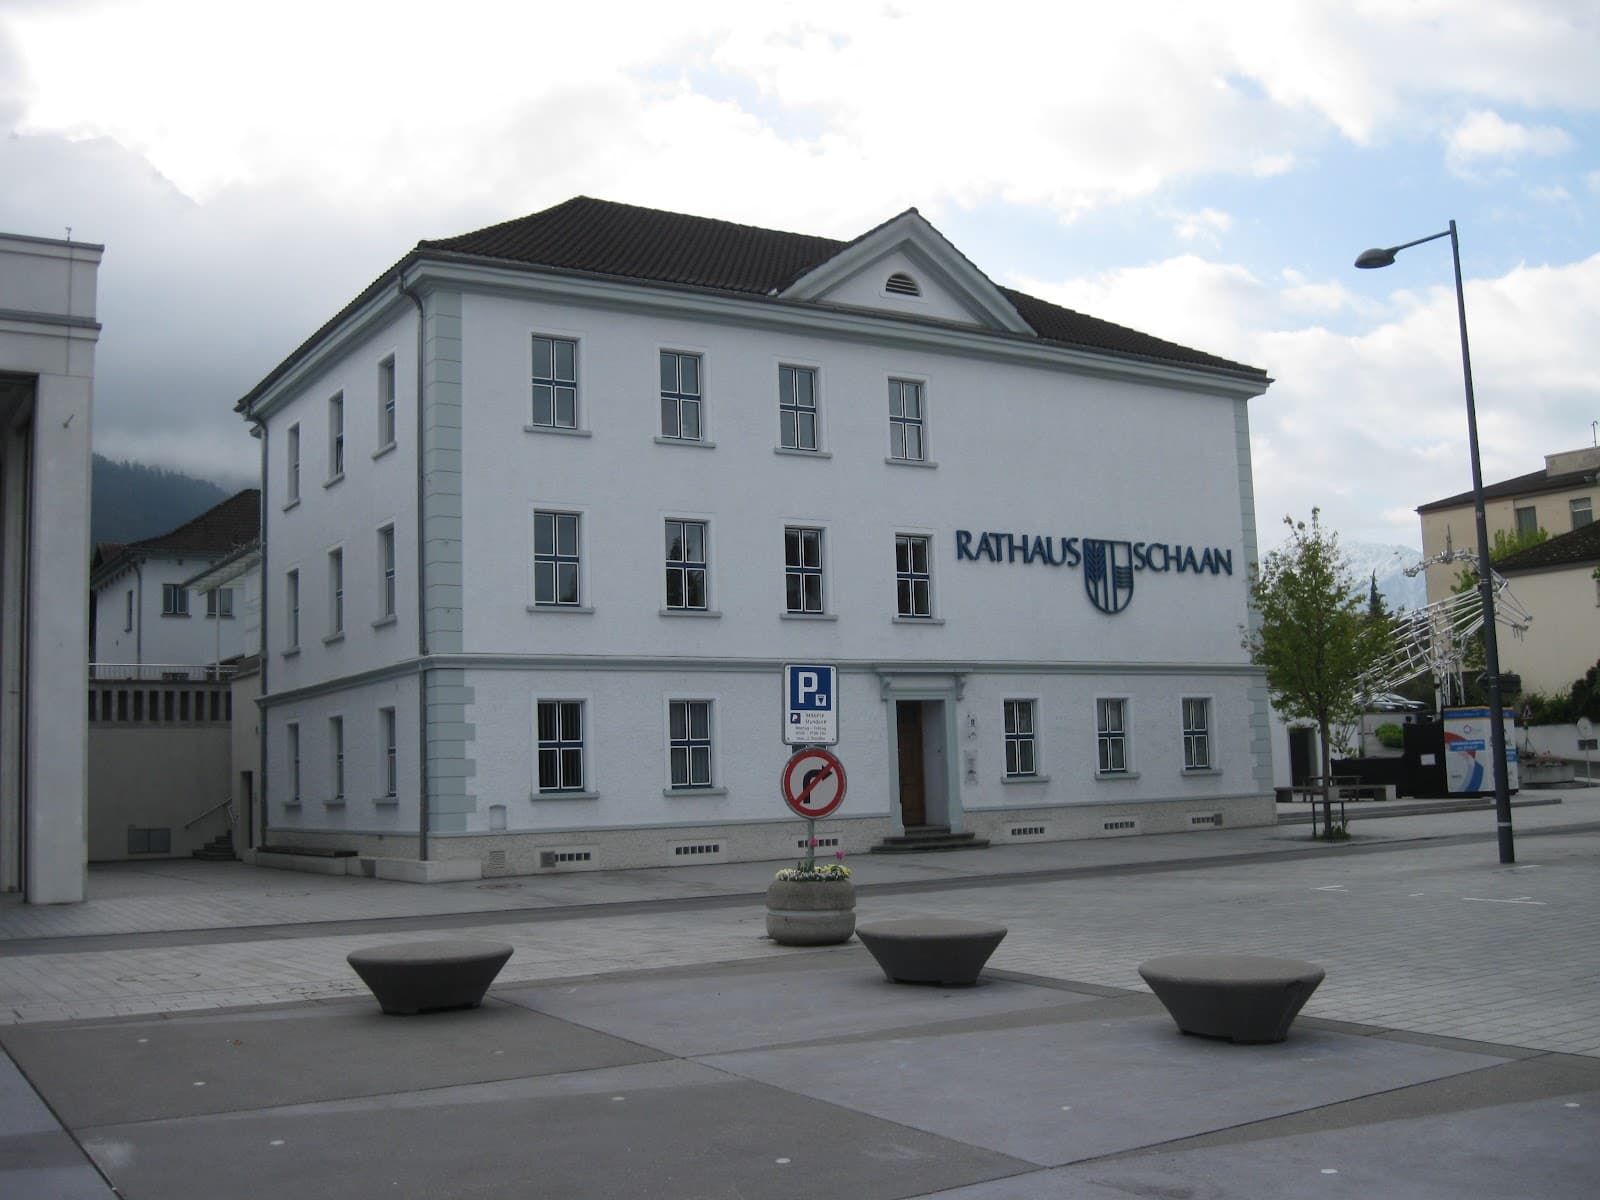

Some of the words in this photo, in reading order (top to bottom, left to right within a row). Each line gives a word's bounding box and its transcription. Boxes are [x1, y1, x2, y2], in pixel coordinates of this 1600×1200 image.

[955, 529, 1082, 567] RATHAUS
[1134, 541, 1233, 576] SCHAAN
[798, 671, 818, 704] P
